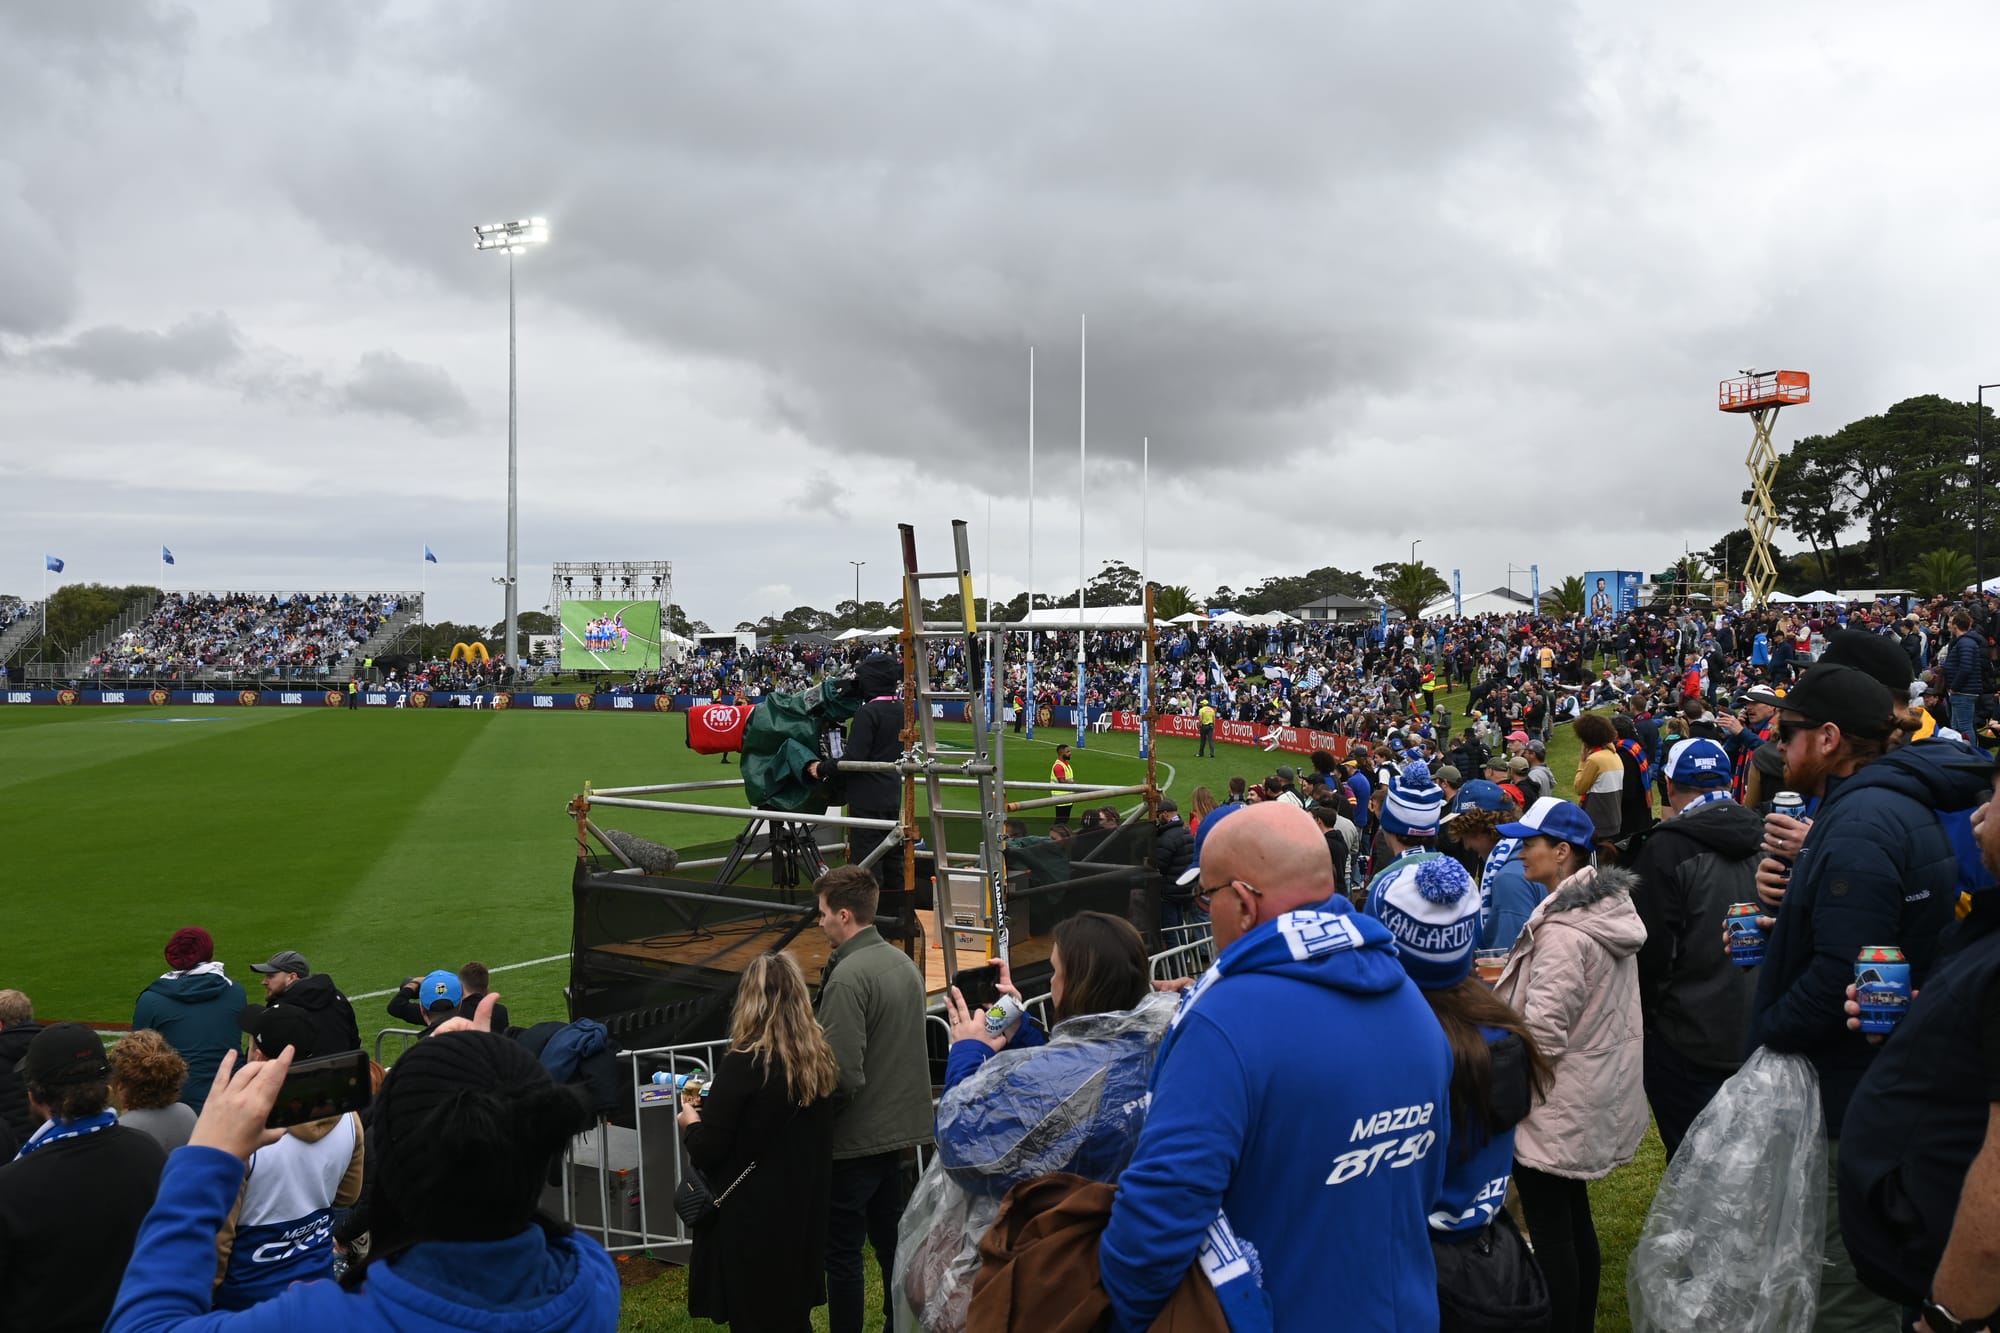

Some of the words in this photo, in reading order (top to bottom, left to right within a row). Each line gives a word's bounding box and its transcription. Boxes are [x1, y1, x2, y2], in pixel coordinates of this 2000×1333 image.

[8, 692, 31, 703] LIONS
[102, 692, 124, 703] LIONS
[192, 692, 214, 703] LIONS
[281, 693, 302, 704] LIONS
[366, 693, 387, 705] LIONS
[533, 696, 553, 707] LIONS
[613, 697, 633, 709] LIONS
[710, 709, 733, 722] FOX
[1231, 723, 1254, 737] TOYOTA
[1279, 728, 1298, 744] OYOTA
[1317, 735, 1336, 751] TOYOTA
[1325, 1130, 1435, 1185] BT-50
